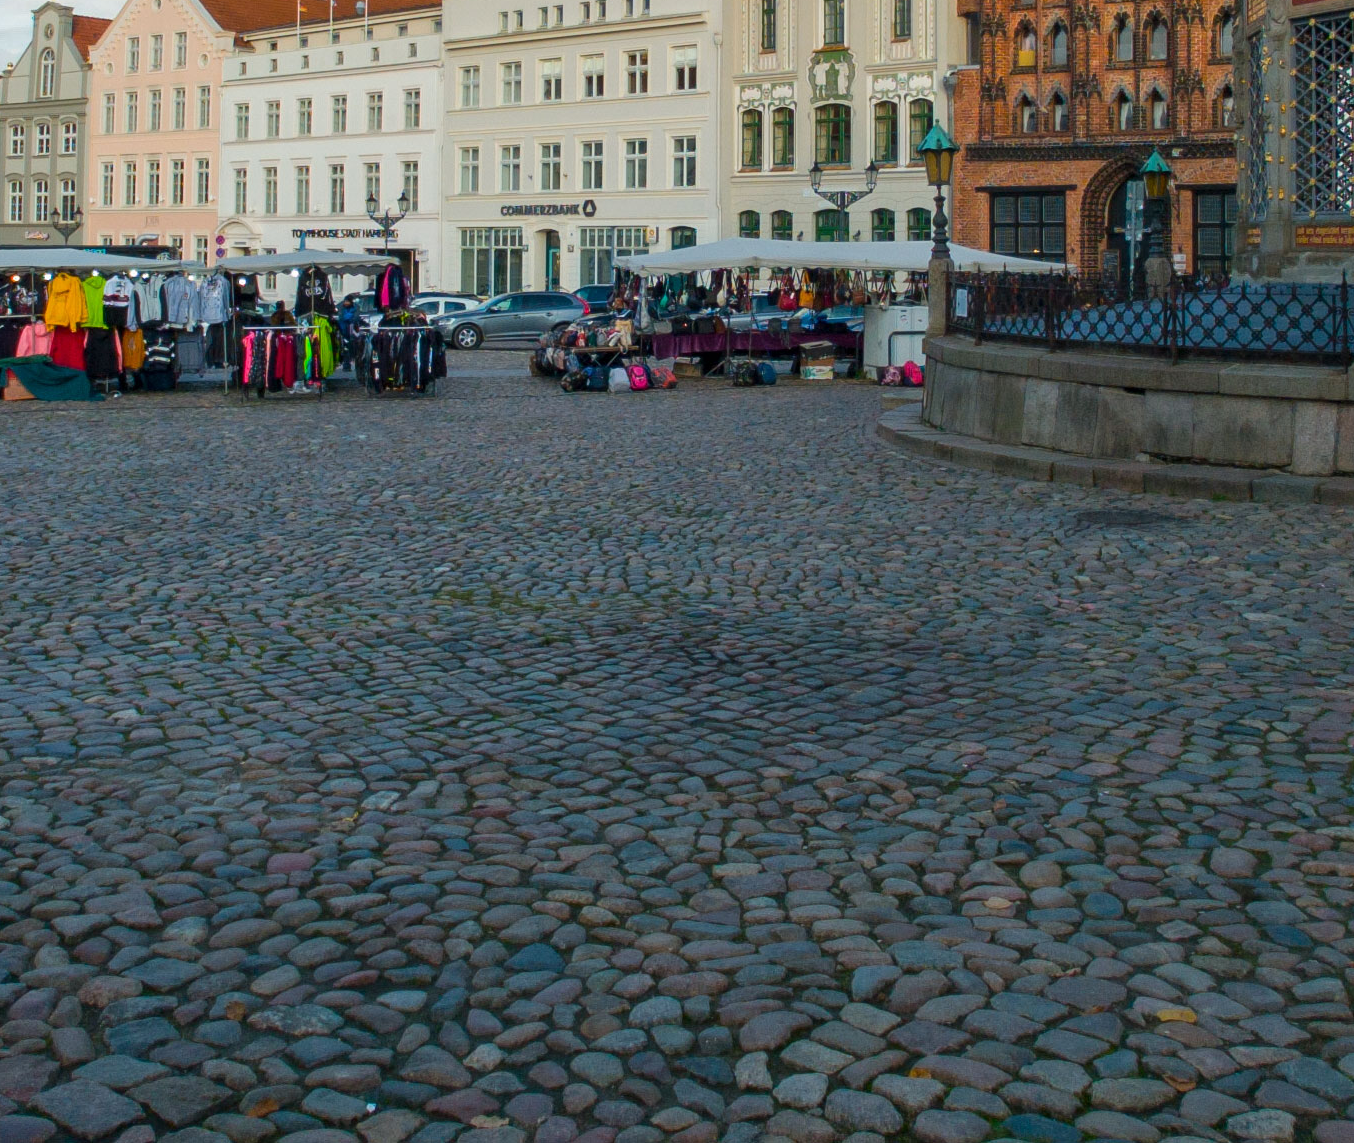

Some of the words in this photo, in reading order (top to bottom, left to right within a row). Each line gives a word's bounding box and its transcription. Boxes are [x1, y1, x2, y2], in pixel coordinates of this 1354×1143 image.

[500, 204, 580, 216] COMMERZBANK
[341, 229, 361, 238] STADT
[362, 229, 399, 238] HAMBRG
